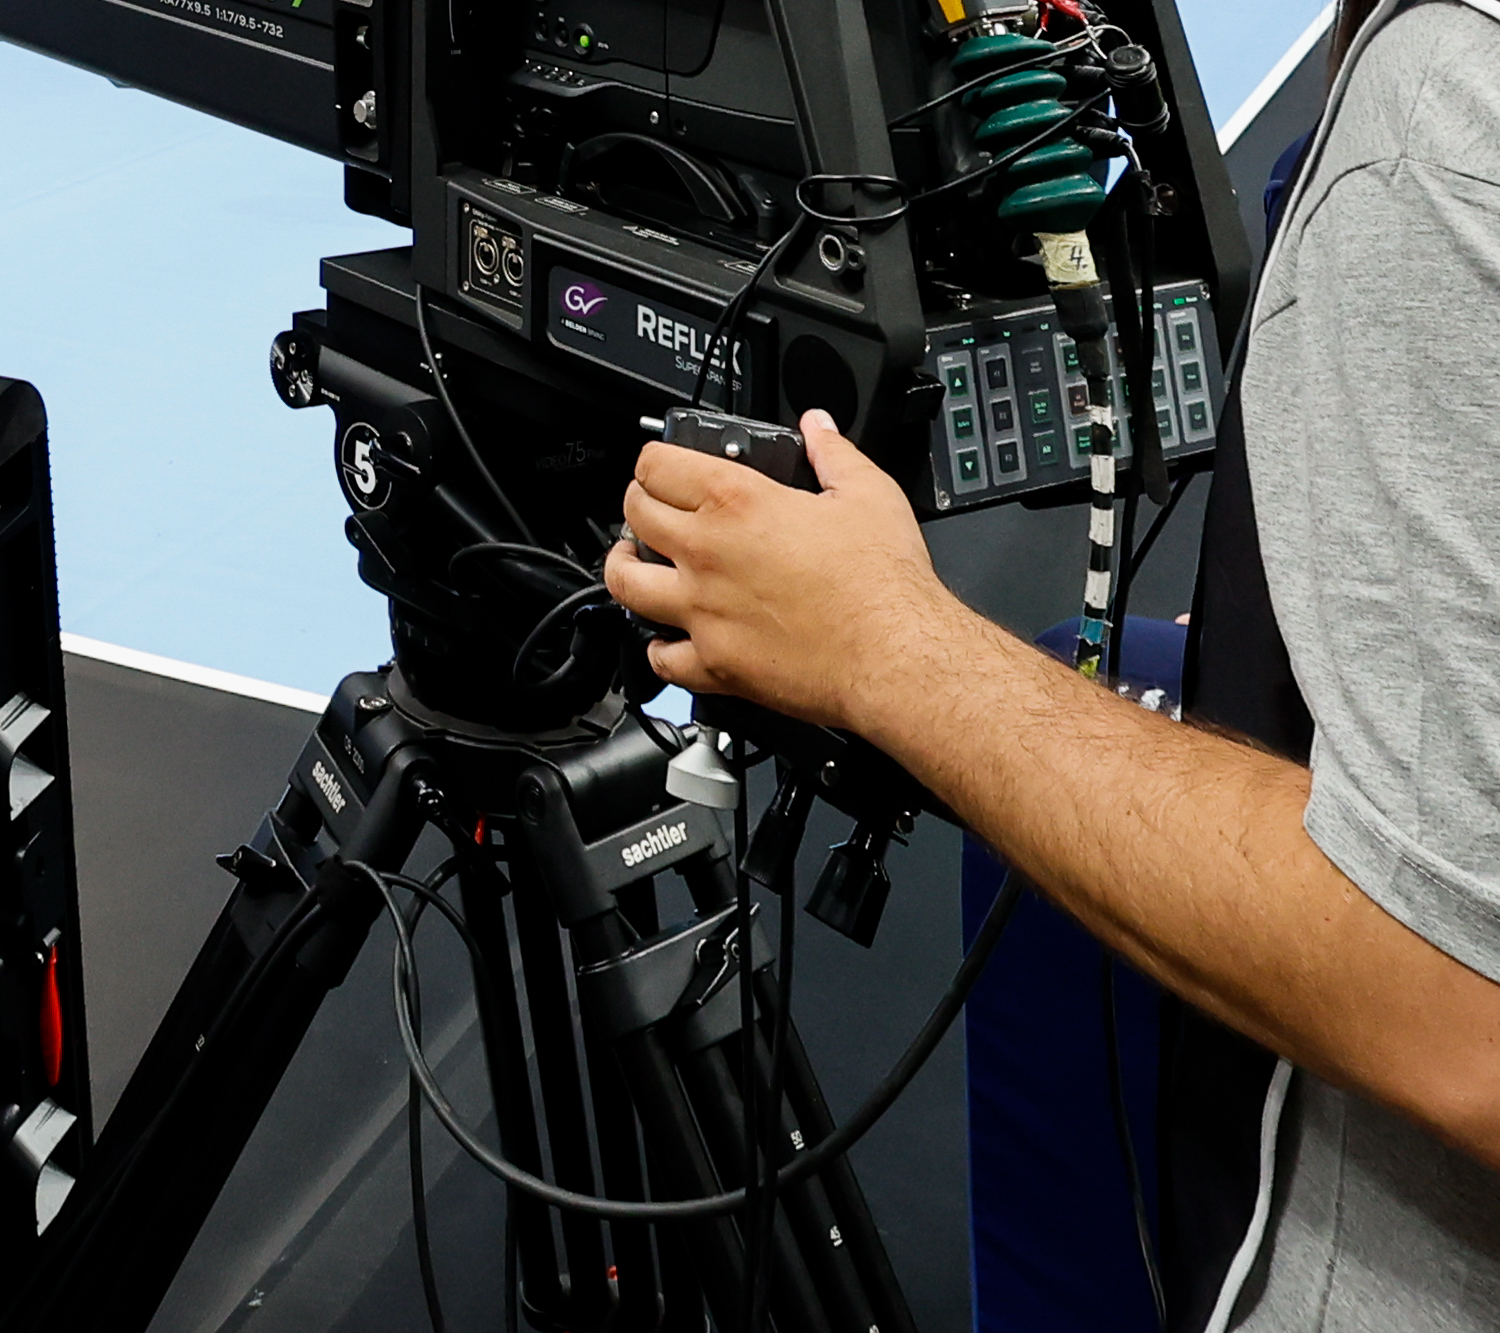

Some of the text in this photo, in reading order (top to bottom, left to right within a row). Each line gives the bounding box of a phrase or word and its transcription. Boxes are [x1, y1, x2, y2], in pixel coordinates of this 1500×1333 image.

[354, 439, 378, 494] 5
[312, 760, 346, 814] sachtler
[621, 821, 688, 867] sachtler
